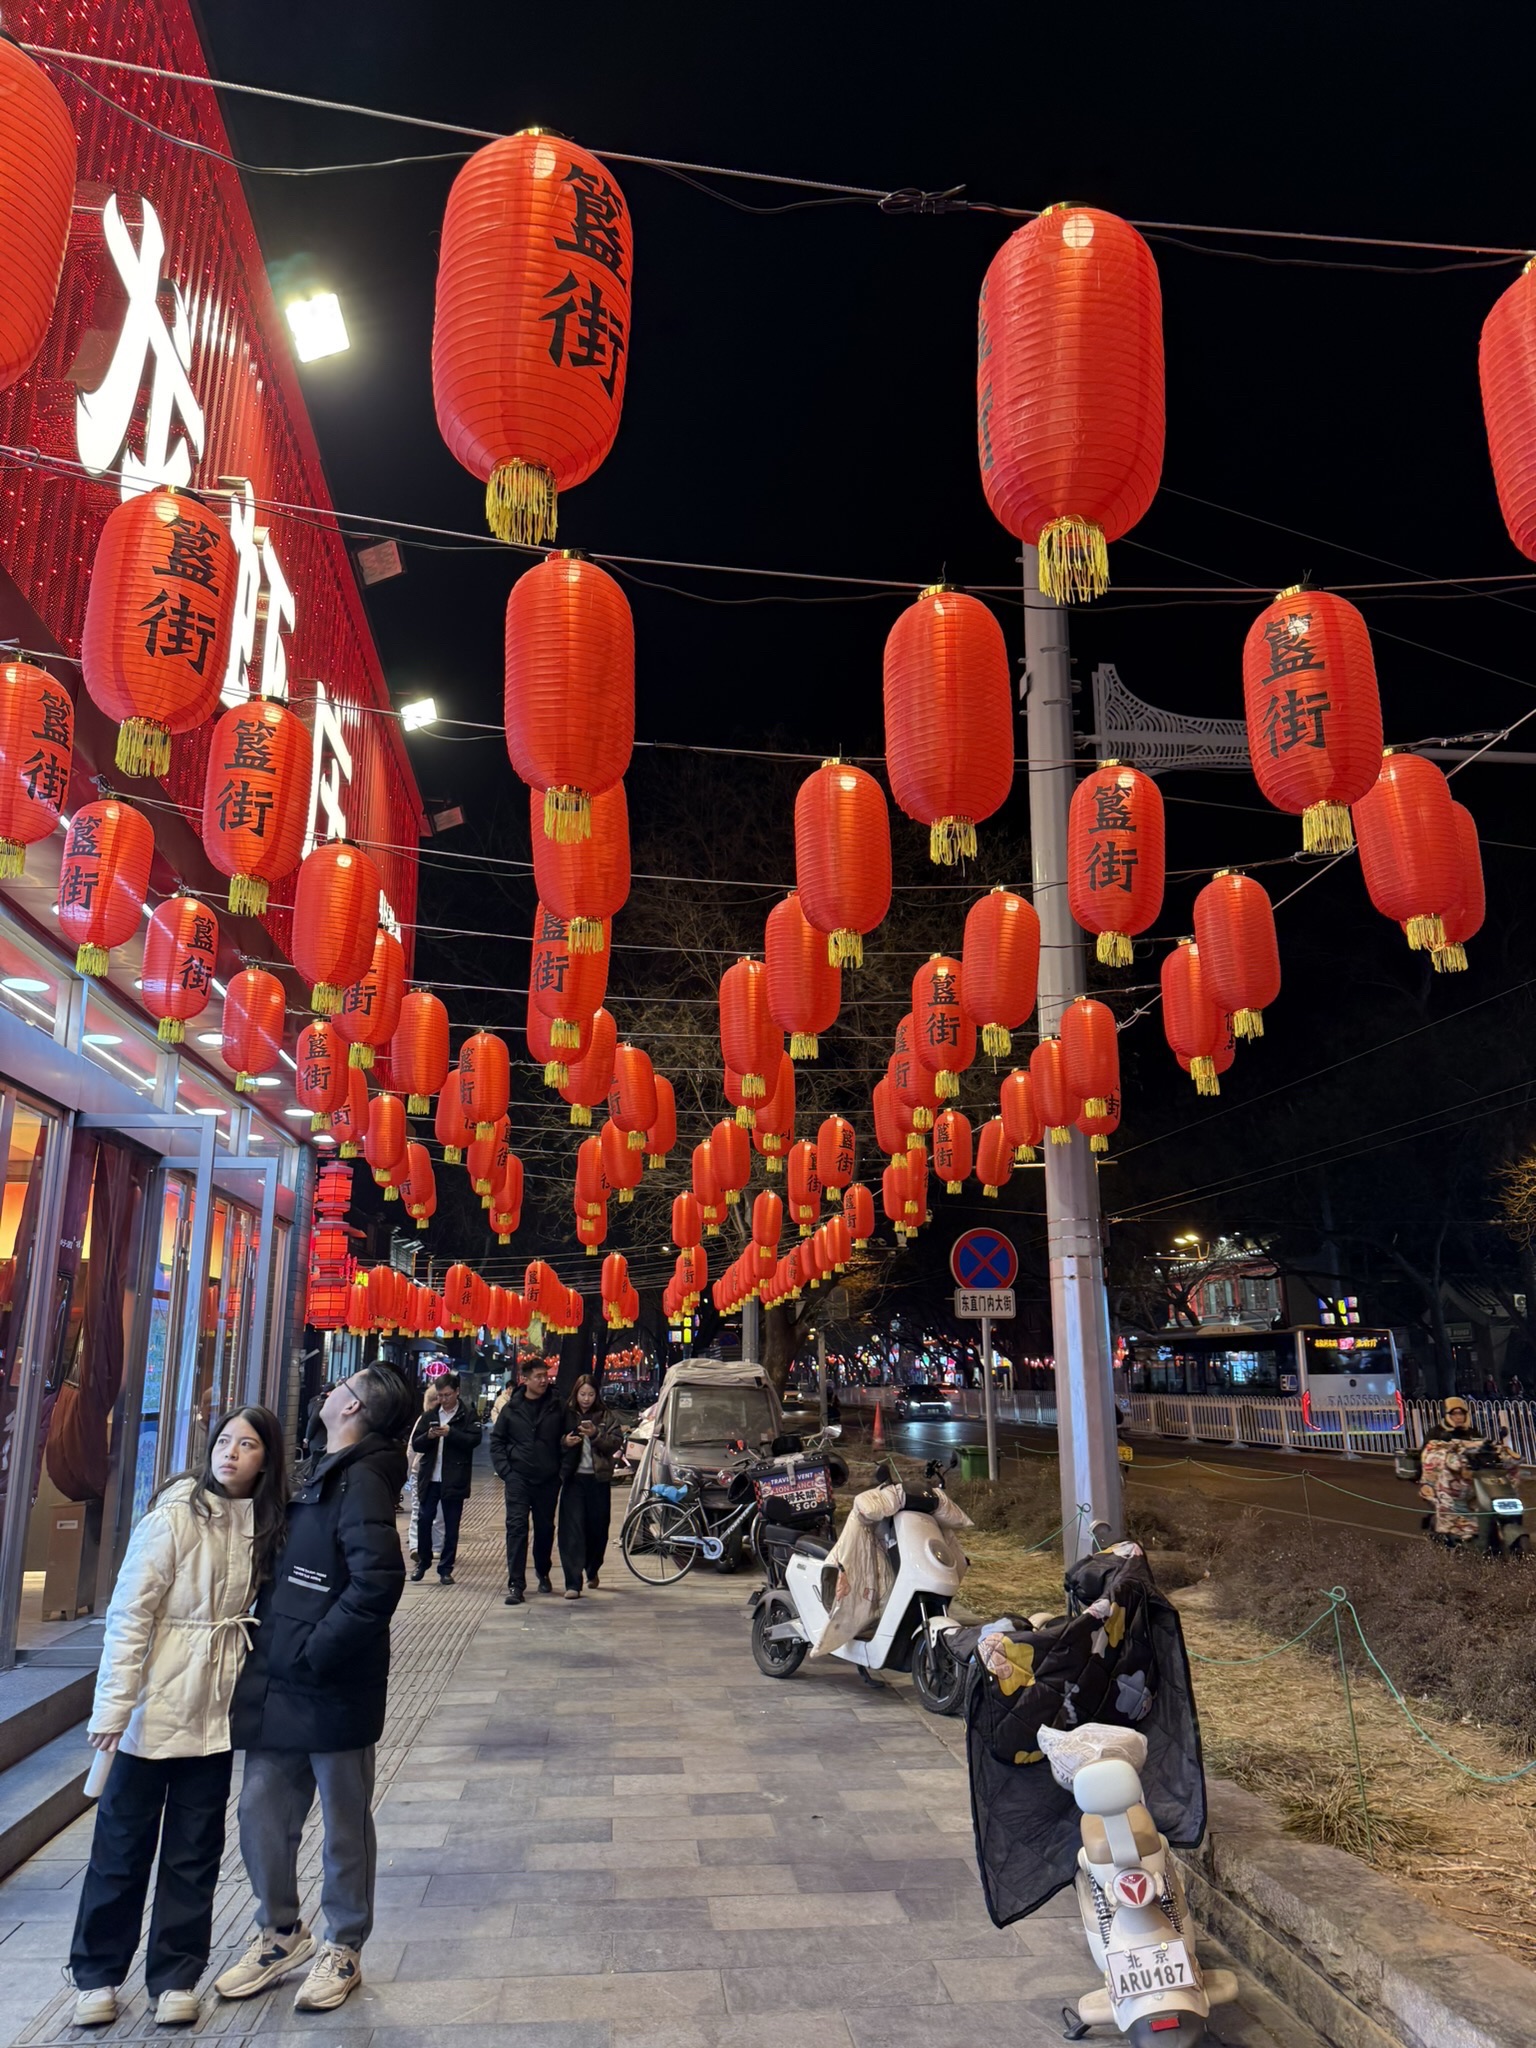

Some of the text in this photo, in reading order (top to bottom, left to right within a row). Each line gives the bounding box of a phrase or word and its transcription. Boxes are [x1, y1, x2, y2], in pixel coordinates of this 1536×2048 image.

[538, 162, 627, 399] 簋街
[138, 513, 222, 674] 簋街
[1261, 613, 1332, 759] 簋街
[23, 690, 72, 812] 簋街
[215, 719, 277, 837] 簋街
[60, 817, 103, 910] 簋街
[1084, 784, 1138, 894] 簋街
[180, 915, 215, 997] 簋街
[926, 972, 960, 1046] 簋街
[302, 1033, 331, 1091] 簋街
[836, 1128, 855, 1175] 簋街
[935, 1123, 953, 1168] 簋街
[962, 1295, 1011, 1311] 东直门内大街
[803, 1501, 817, 1509] GO
[1120, 1963, 1184, 1994] ARU187
[1127, 1949, 1169, 1969] 北京
